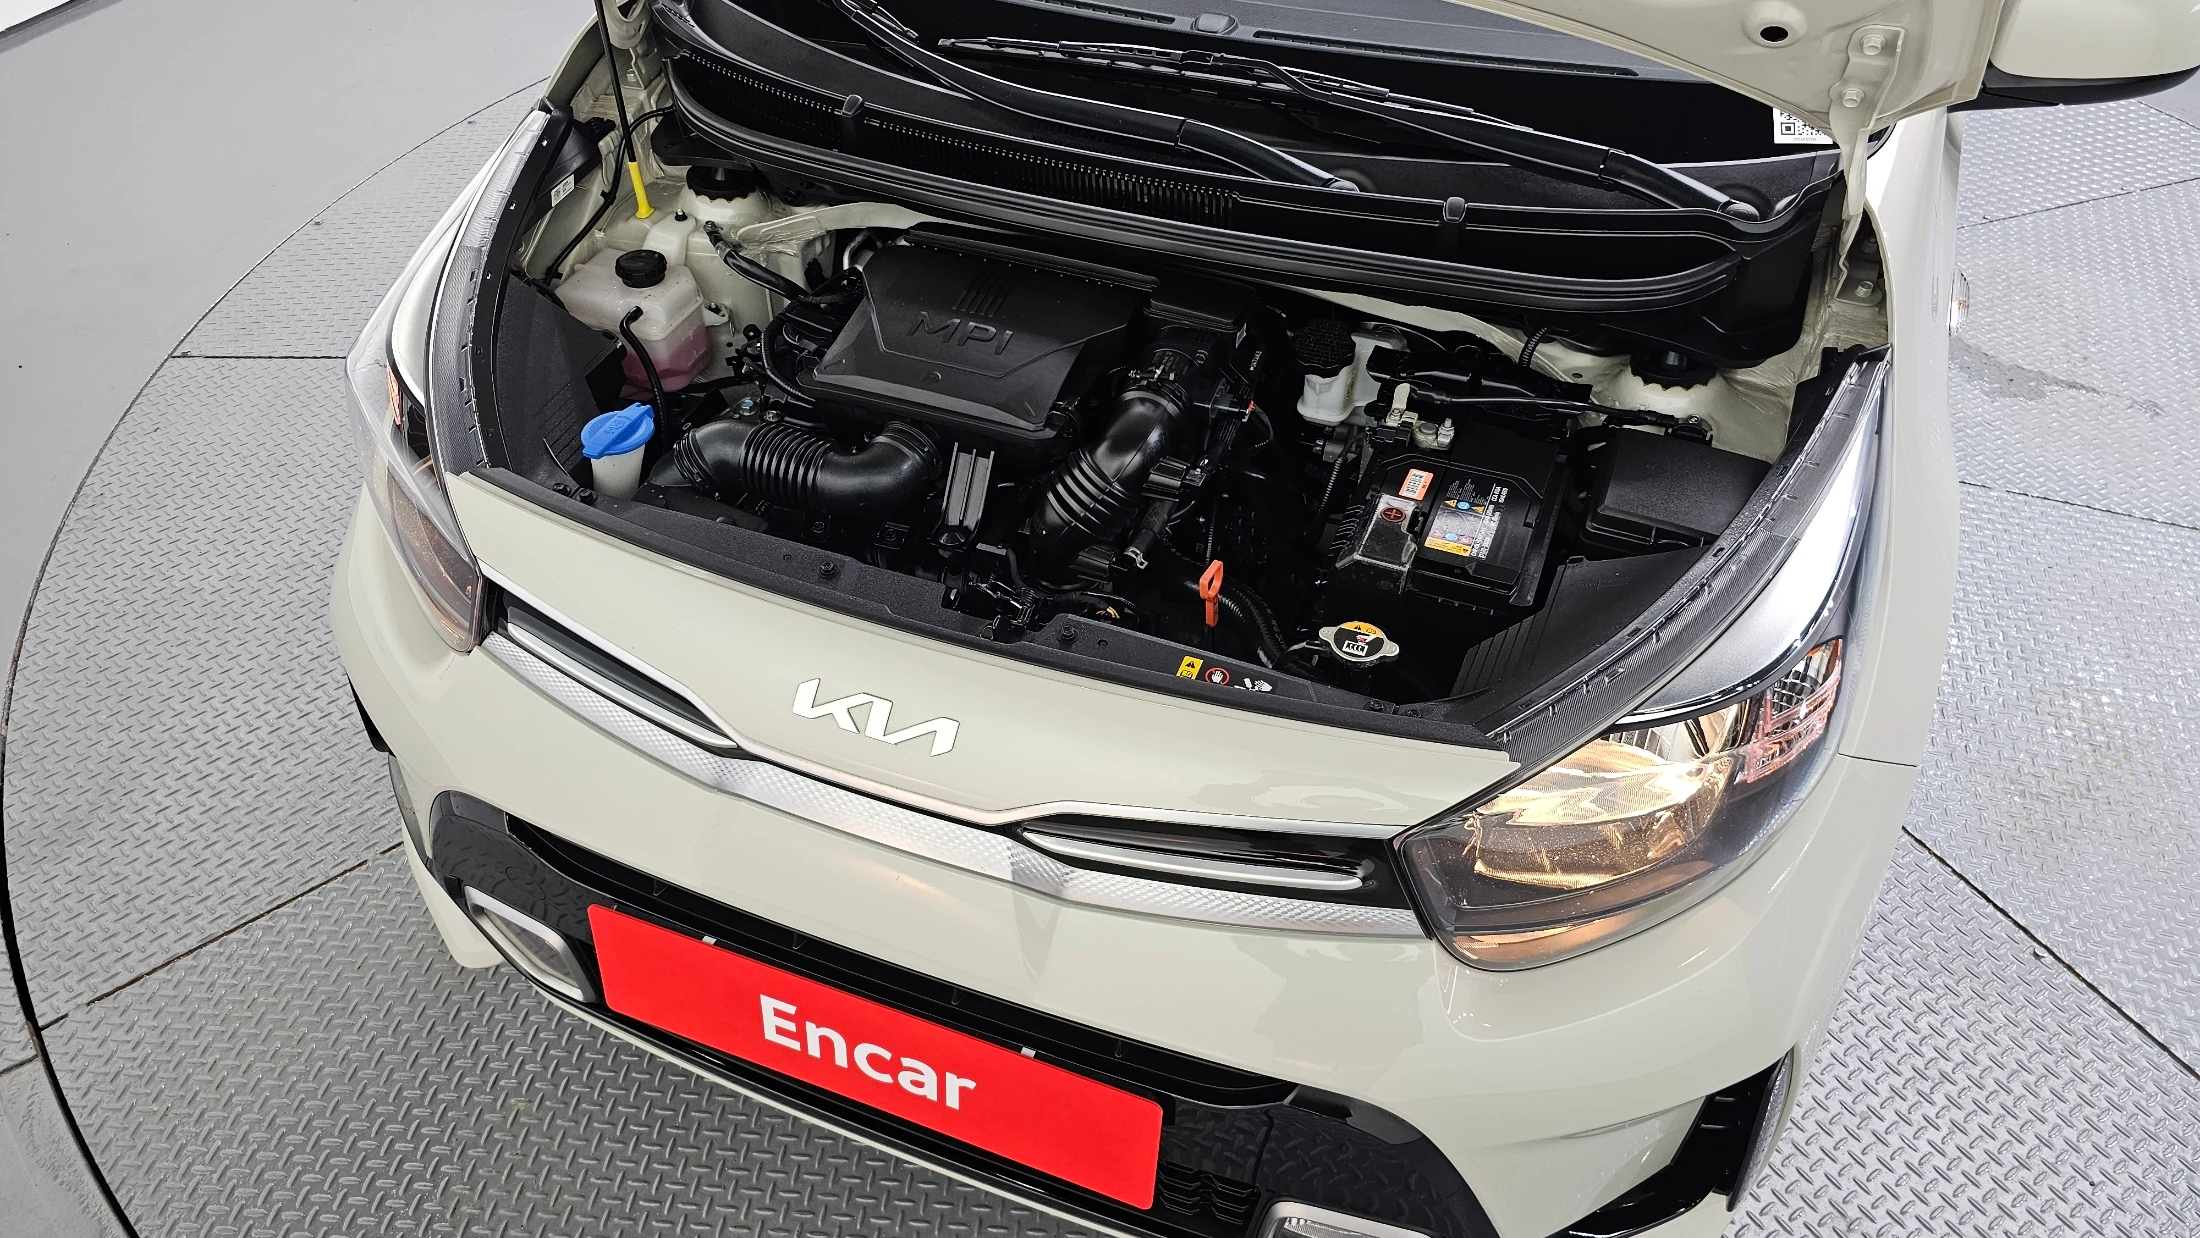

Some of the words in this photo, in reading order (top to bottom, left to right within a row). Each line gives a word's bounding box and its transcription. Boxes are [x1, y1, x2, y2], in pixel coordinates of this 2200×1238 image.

[906, 311, 1014, 355] MPI
[792, 677, 961, 757] KIA
[760, 994, 977, 1110] Encar
